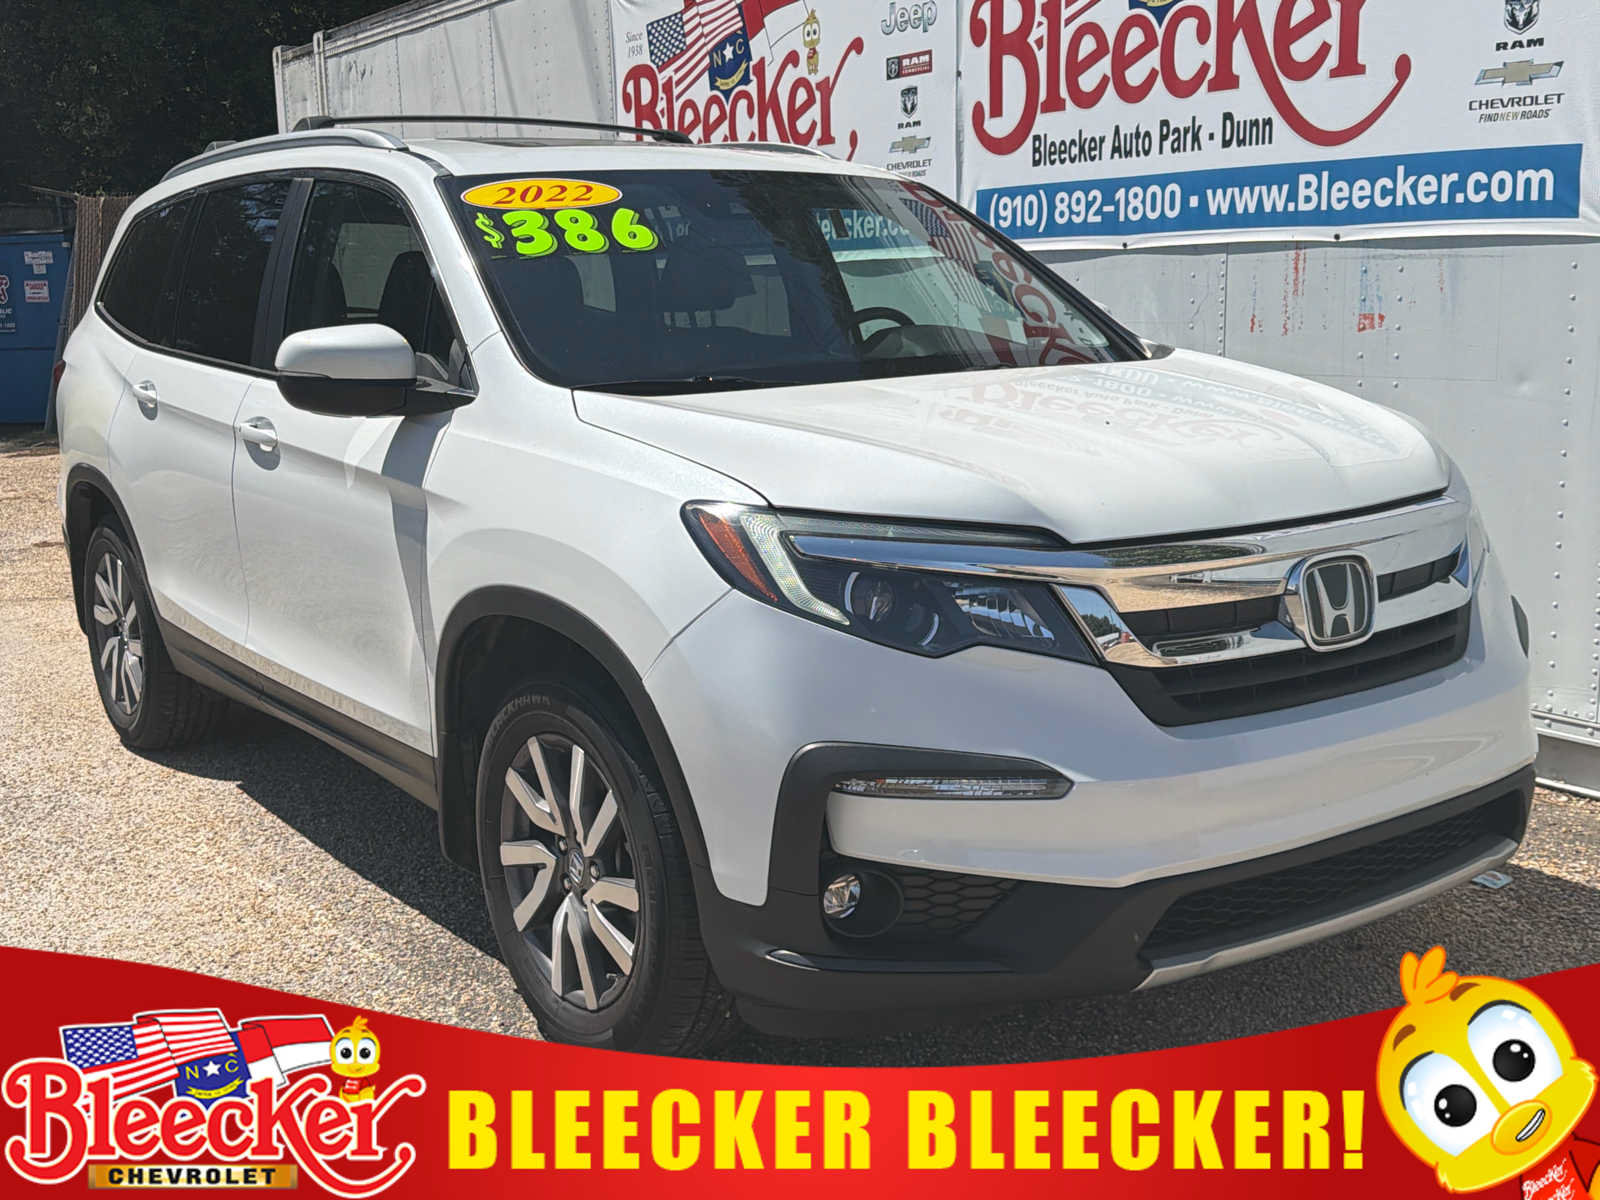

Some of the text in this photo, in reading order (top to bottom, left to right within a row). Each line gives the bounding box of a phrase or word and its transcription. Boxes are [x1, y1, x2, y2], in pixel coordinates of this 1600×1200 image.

[881, 0, 938, 35] Jeep
[1495, 37, 1545, 51] RAM
[902, 54, 930, 67] RAM
[622, 37, 865, 161] Bleecker
[1468, 92, 1565, 112] CHEVROLET
[897, 120, 921, 129] RAM
[1032, 112, 1273, 167] Bleecker Auto Park Dunn
[886, 158, 932, 171] CHEVROLET
[491, 184, 594, 206] 2022
[990, 165, 1555, 233] (910) 892-1800 www.Bleecker.com
[475, 207, 659, 258] $386
